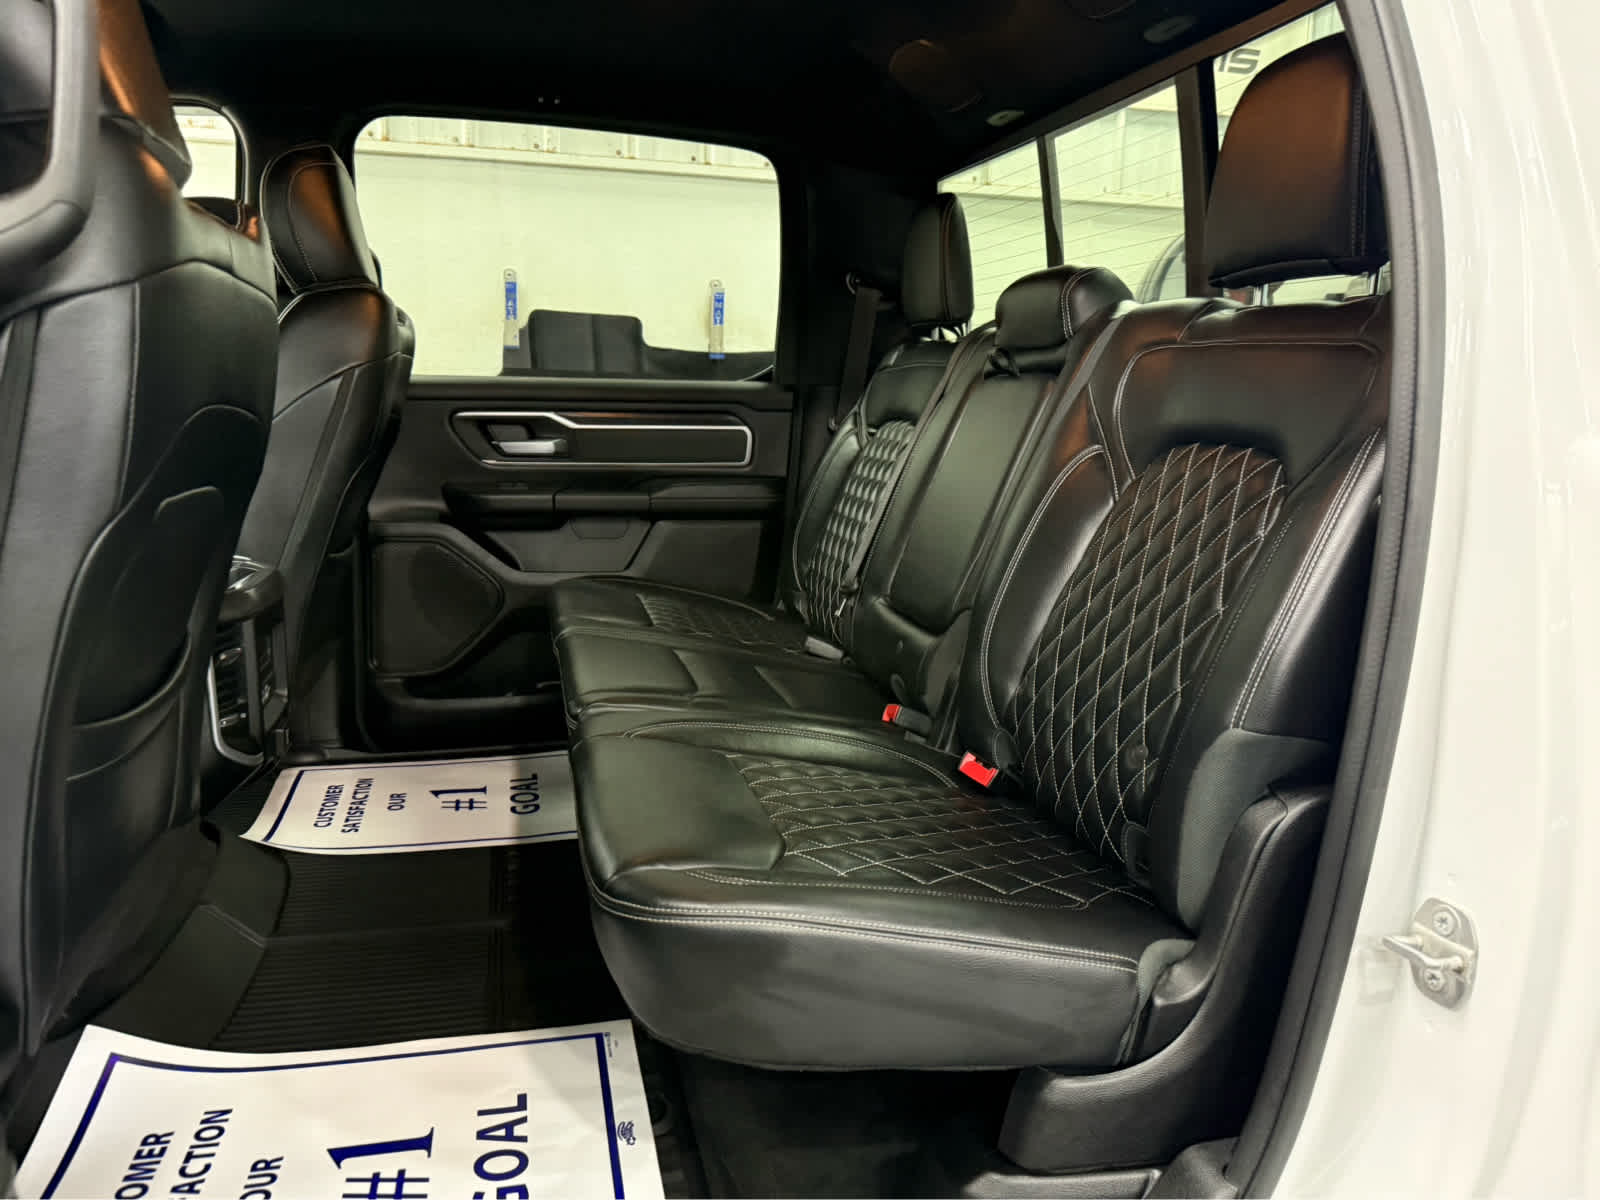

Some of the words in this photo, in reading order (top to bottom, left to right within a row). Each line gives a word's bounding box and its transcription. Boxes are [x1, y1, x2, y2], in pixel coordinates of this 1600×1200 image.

[313, 784, 345, 828] CUSTOMER
[340, 778, 375, 834] SATISFACTION
[387, 792, 407, 811] OUR
[429, 785, 488, 812] #1
[509, 773, 540, 815] GOAL
[168, 1108, 233, 1200] ACTION
[328, 1127, 434, 1200] #1
